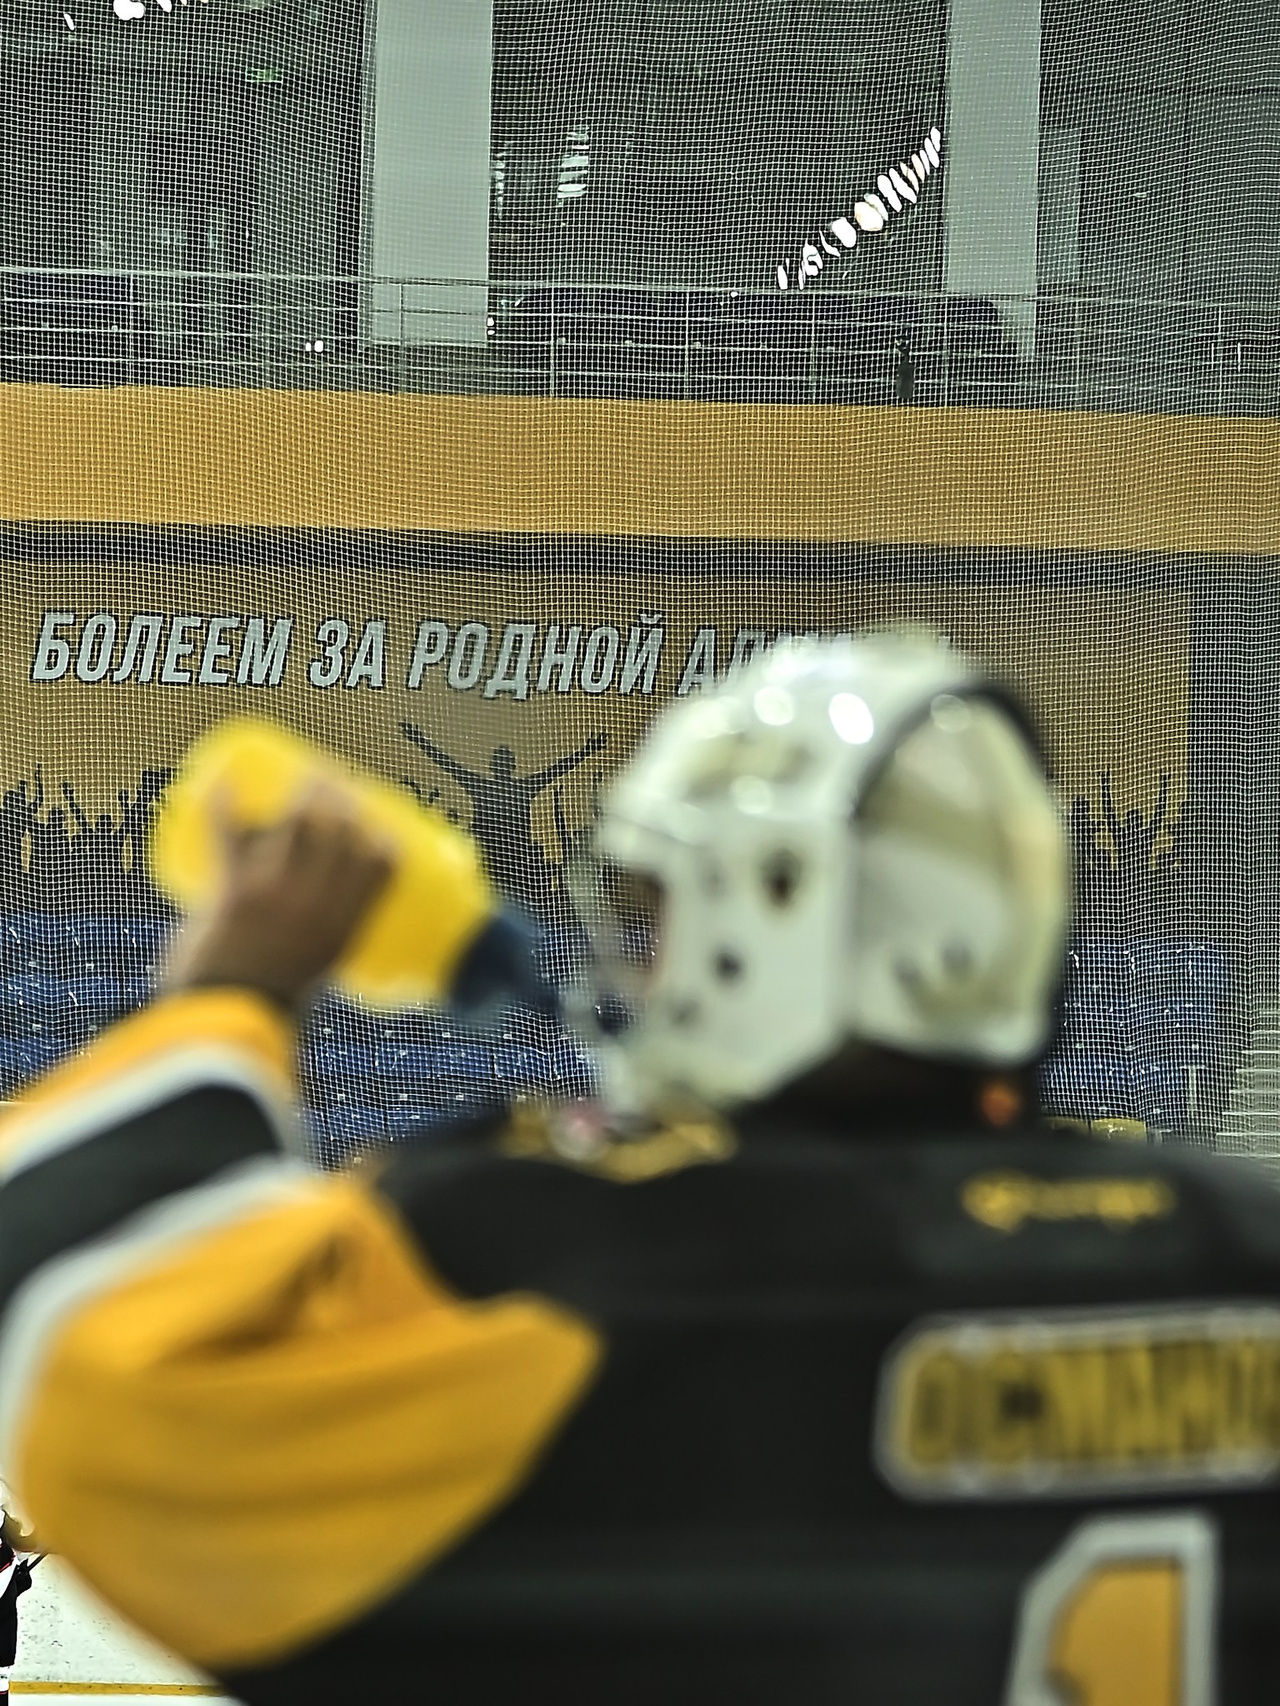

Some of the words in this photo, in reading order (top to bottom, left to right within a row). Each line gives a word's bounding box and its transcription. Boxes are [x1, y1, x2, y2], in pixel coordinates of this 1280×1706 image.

[29, 611, 295, 688] БОЛЕЕМ
[309, 617, 387, 691] ЗА
[406, 611, 664, 701] РОДНОЙ
